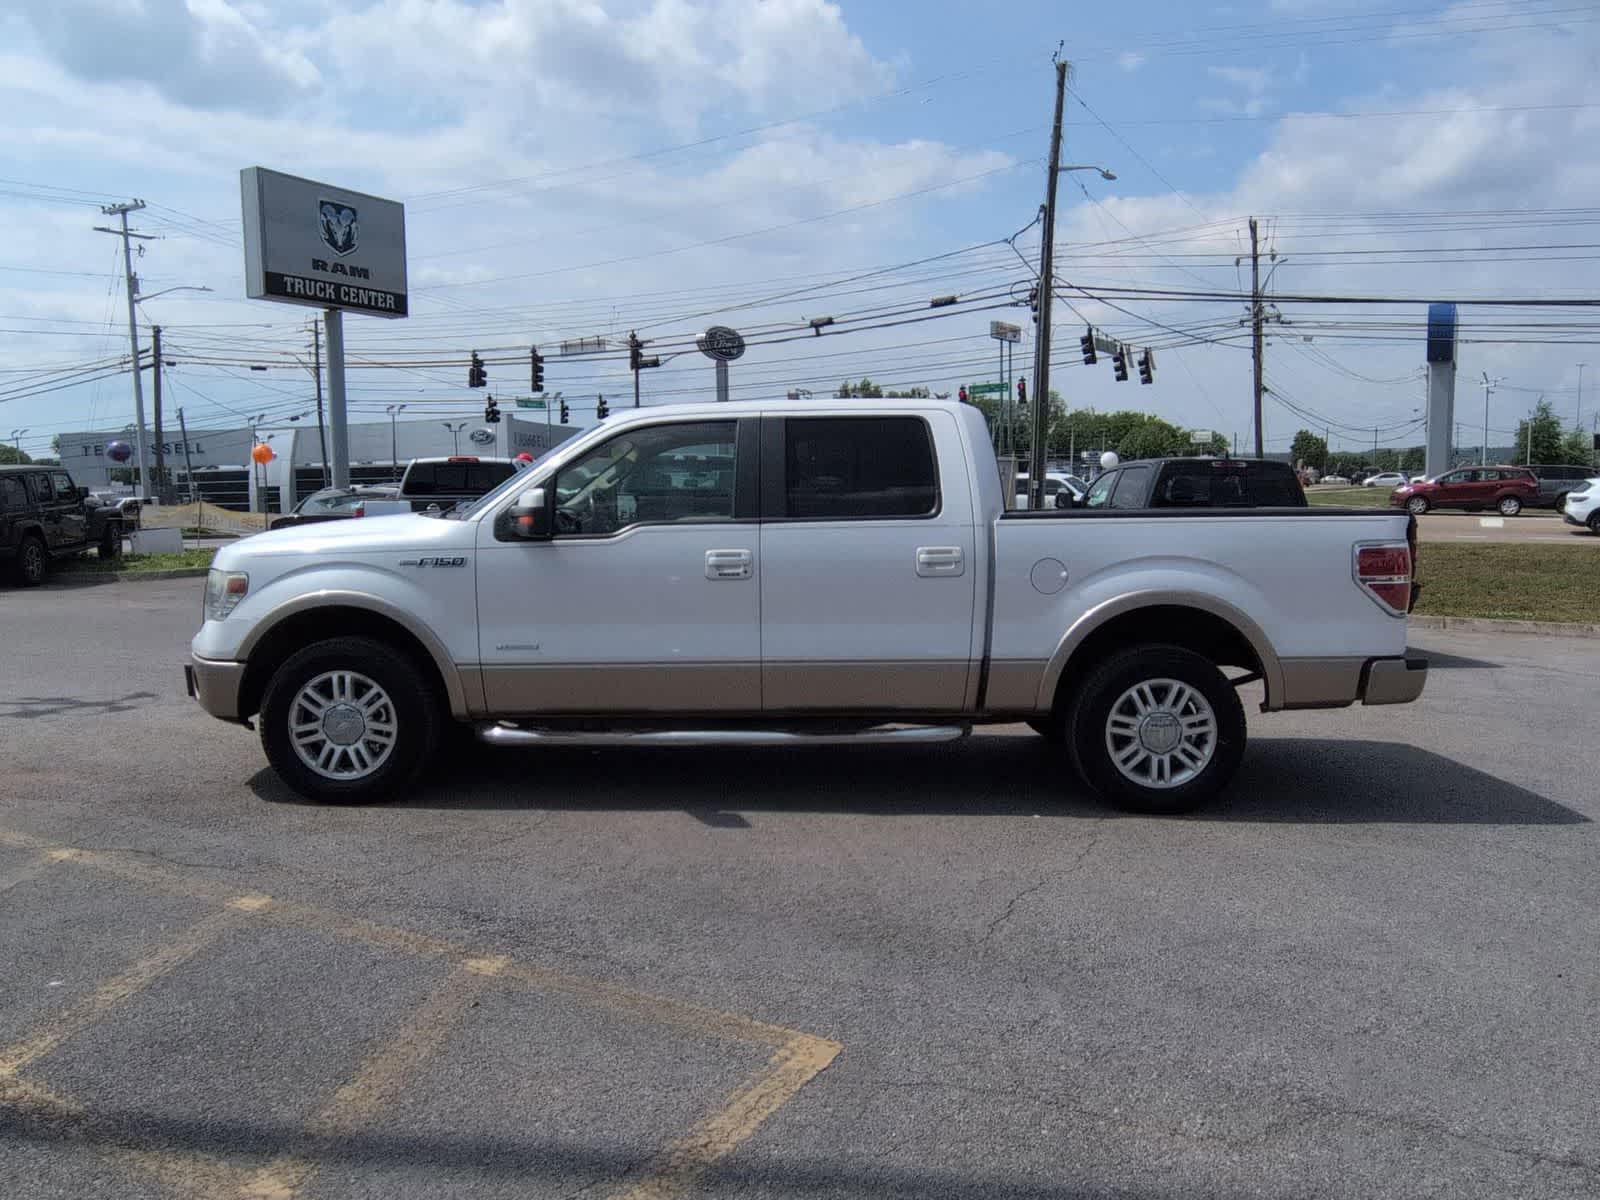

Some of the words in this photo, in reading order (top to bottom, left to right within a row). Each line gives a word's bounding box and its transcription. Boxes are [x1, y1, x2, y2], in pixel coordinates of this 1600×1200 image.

[312, 258, 370, 280] RAM
[284, 276, 336, 300] TRUCK
[340, 286, 396, 310] CENTER
